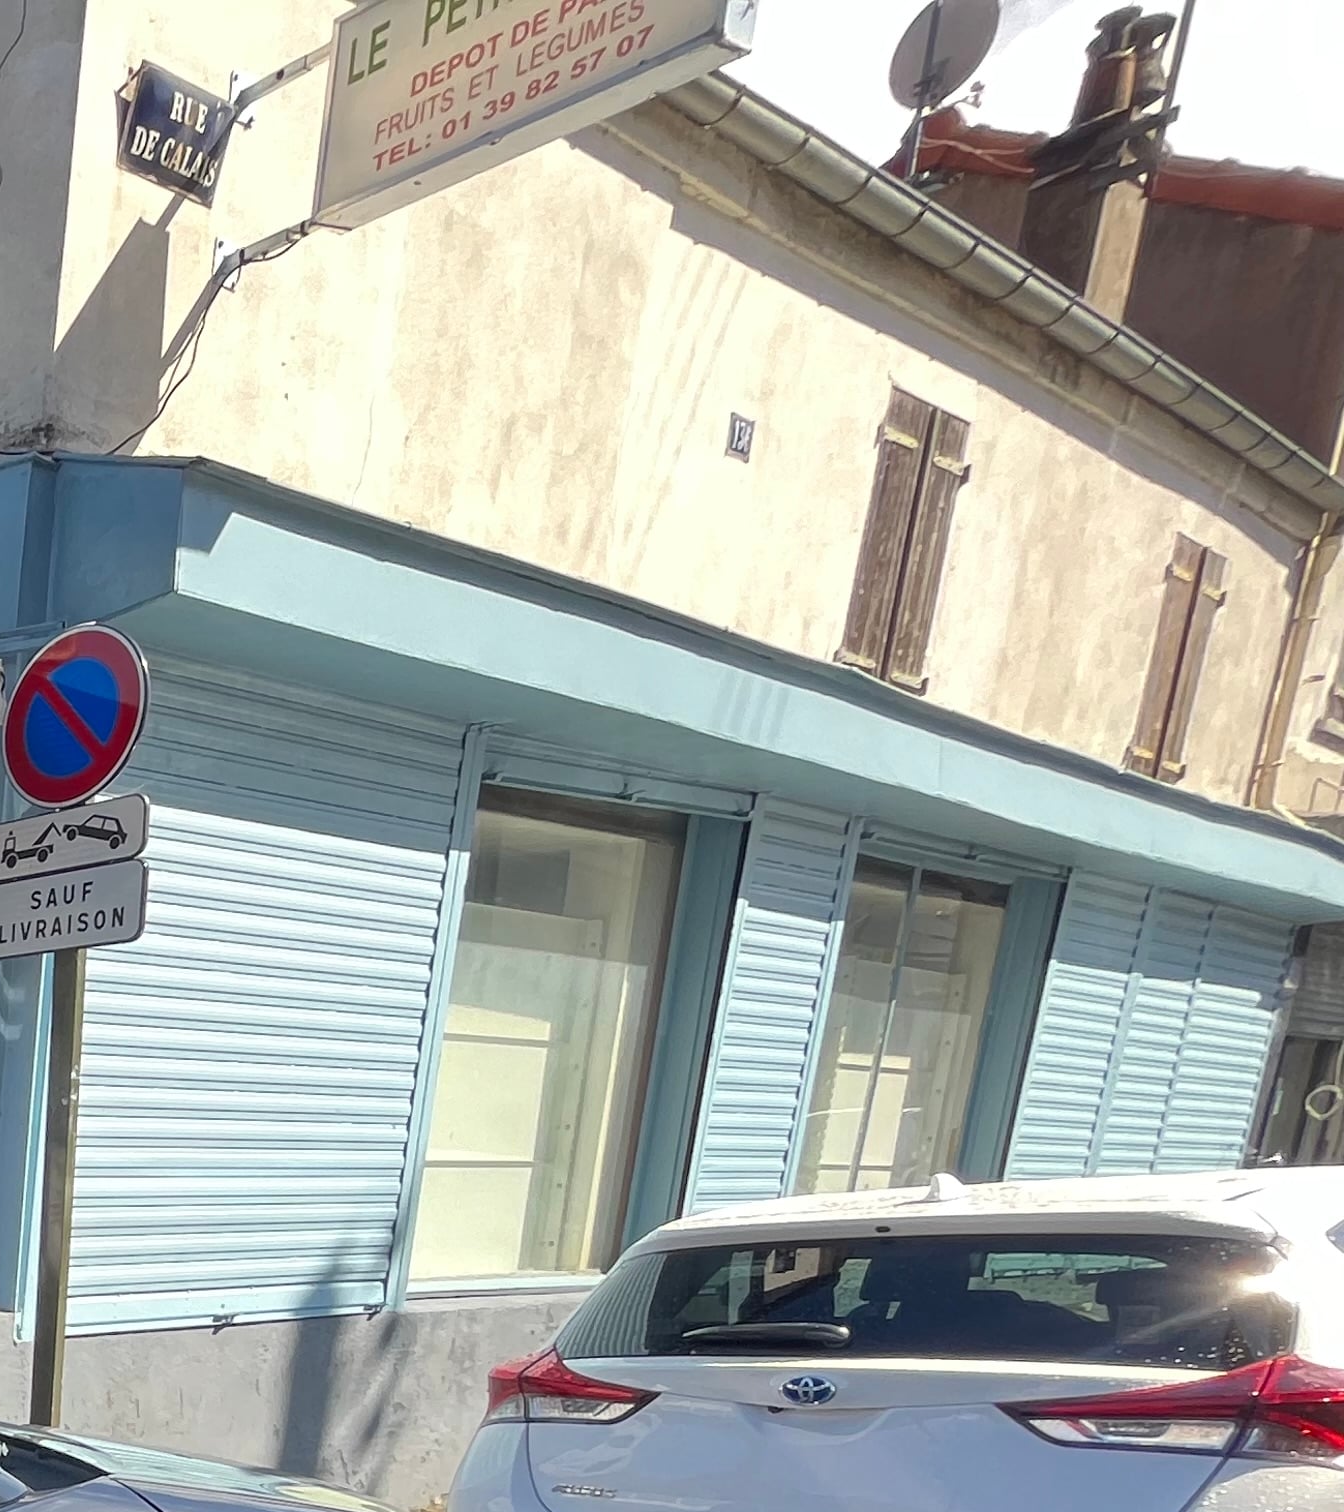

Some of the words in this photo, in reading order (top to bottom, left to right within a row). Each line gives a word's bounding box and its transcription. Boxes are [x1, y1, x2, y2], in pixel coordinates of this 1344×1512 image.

[347, 20, 391, 85] LE
[374, 87, 455, 144] FRUITS
[468, 64, 499, 100] ET
[516, 0, 645, 77] LEGUMES
[410, 32, 504, 97] DEPOT
[510, 8, 550, 48] DE
[169, 91, 209, 134] RUE
[373, 133, 432, 172] TEL:
[441, 111, 471, 139] 01
[482, 91, 516, 121] 39
[525, 70, 560, 100] 82
[570, 46, 607, 80] 57
[616, 24, 655, 57] 07
[130, 125, 161, 161] DE
[160, 137, 218, 187] CALAIS
[30, 881, 94, 910] SAUF
